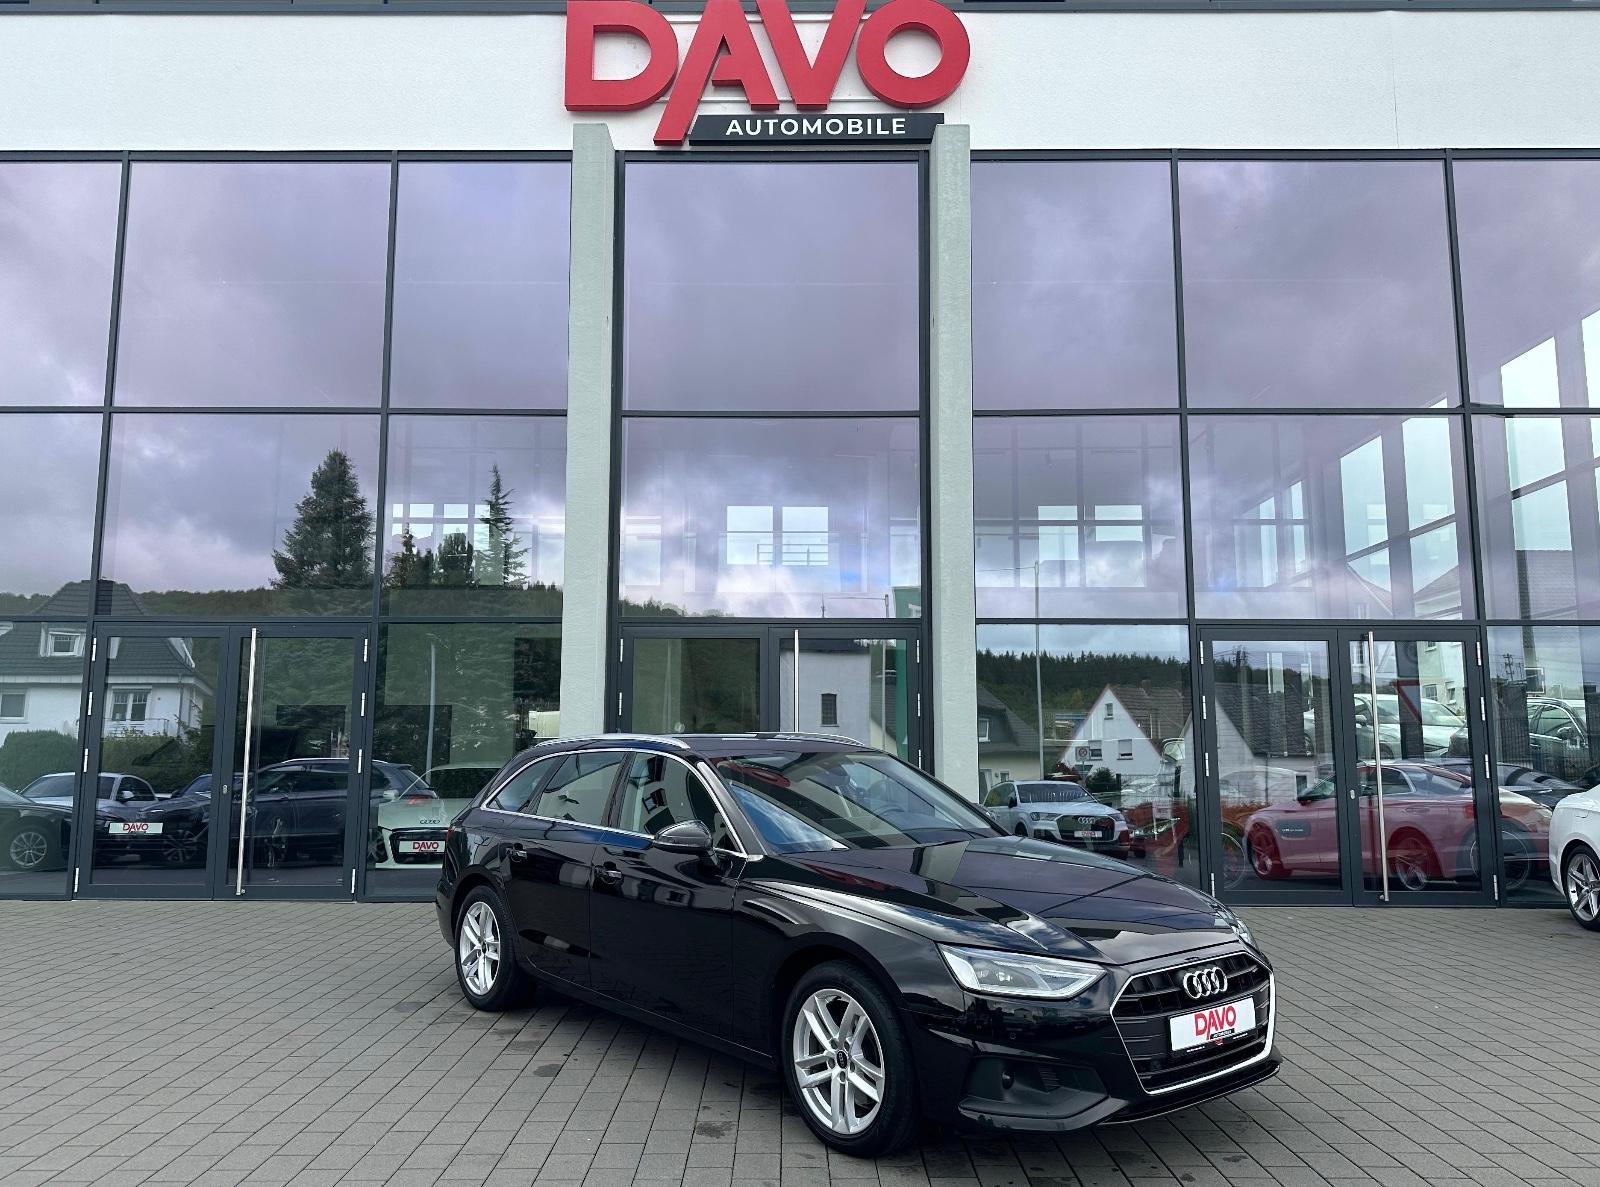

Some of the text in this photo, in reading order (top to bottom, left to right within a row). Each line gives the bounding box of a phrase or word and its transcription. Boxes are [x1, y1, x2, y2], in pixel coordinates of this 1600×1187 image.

[564, 0, 970, 146] DAVO
[725, 117, 906, 137] AUTOMOBILE
[123, 823, 149, 832] DAVO
[412, 841, 439, 851] DAVO
[1194, 1005, 1237, 1040] DAVO
